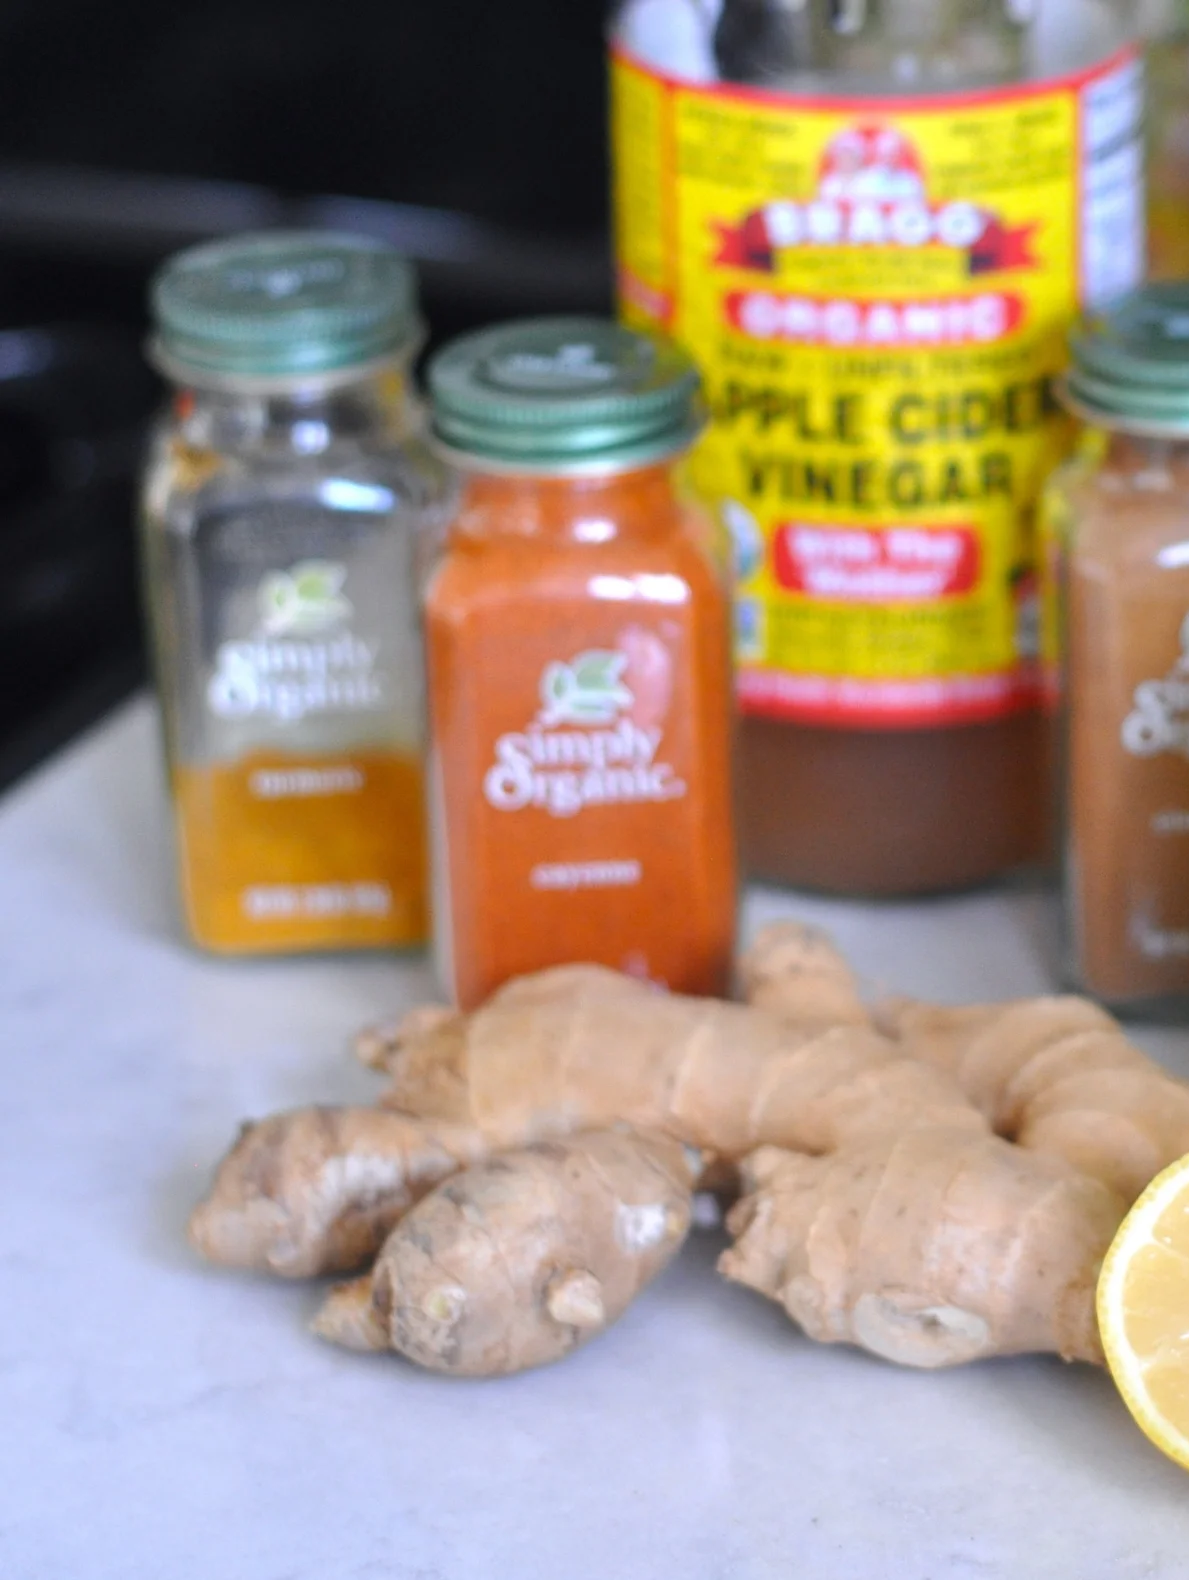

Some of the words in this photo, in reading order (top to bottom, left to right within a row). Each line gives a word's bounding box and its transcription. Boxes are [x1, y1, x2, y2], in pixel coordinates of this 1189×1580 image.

[740, 291, 1007, 344] ORGANIC
[740, 453, 1010, 508] VINEGAR
[495, 720, 664, 776] Simply
